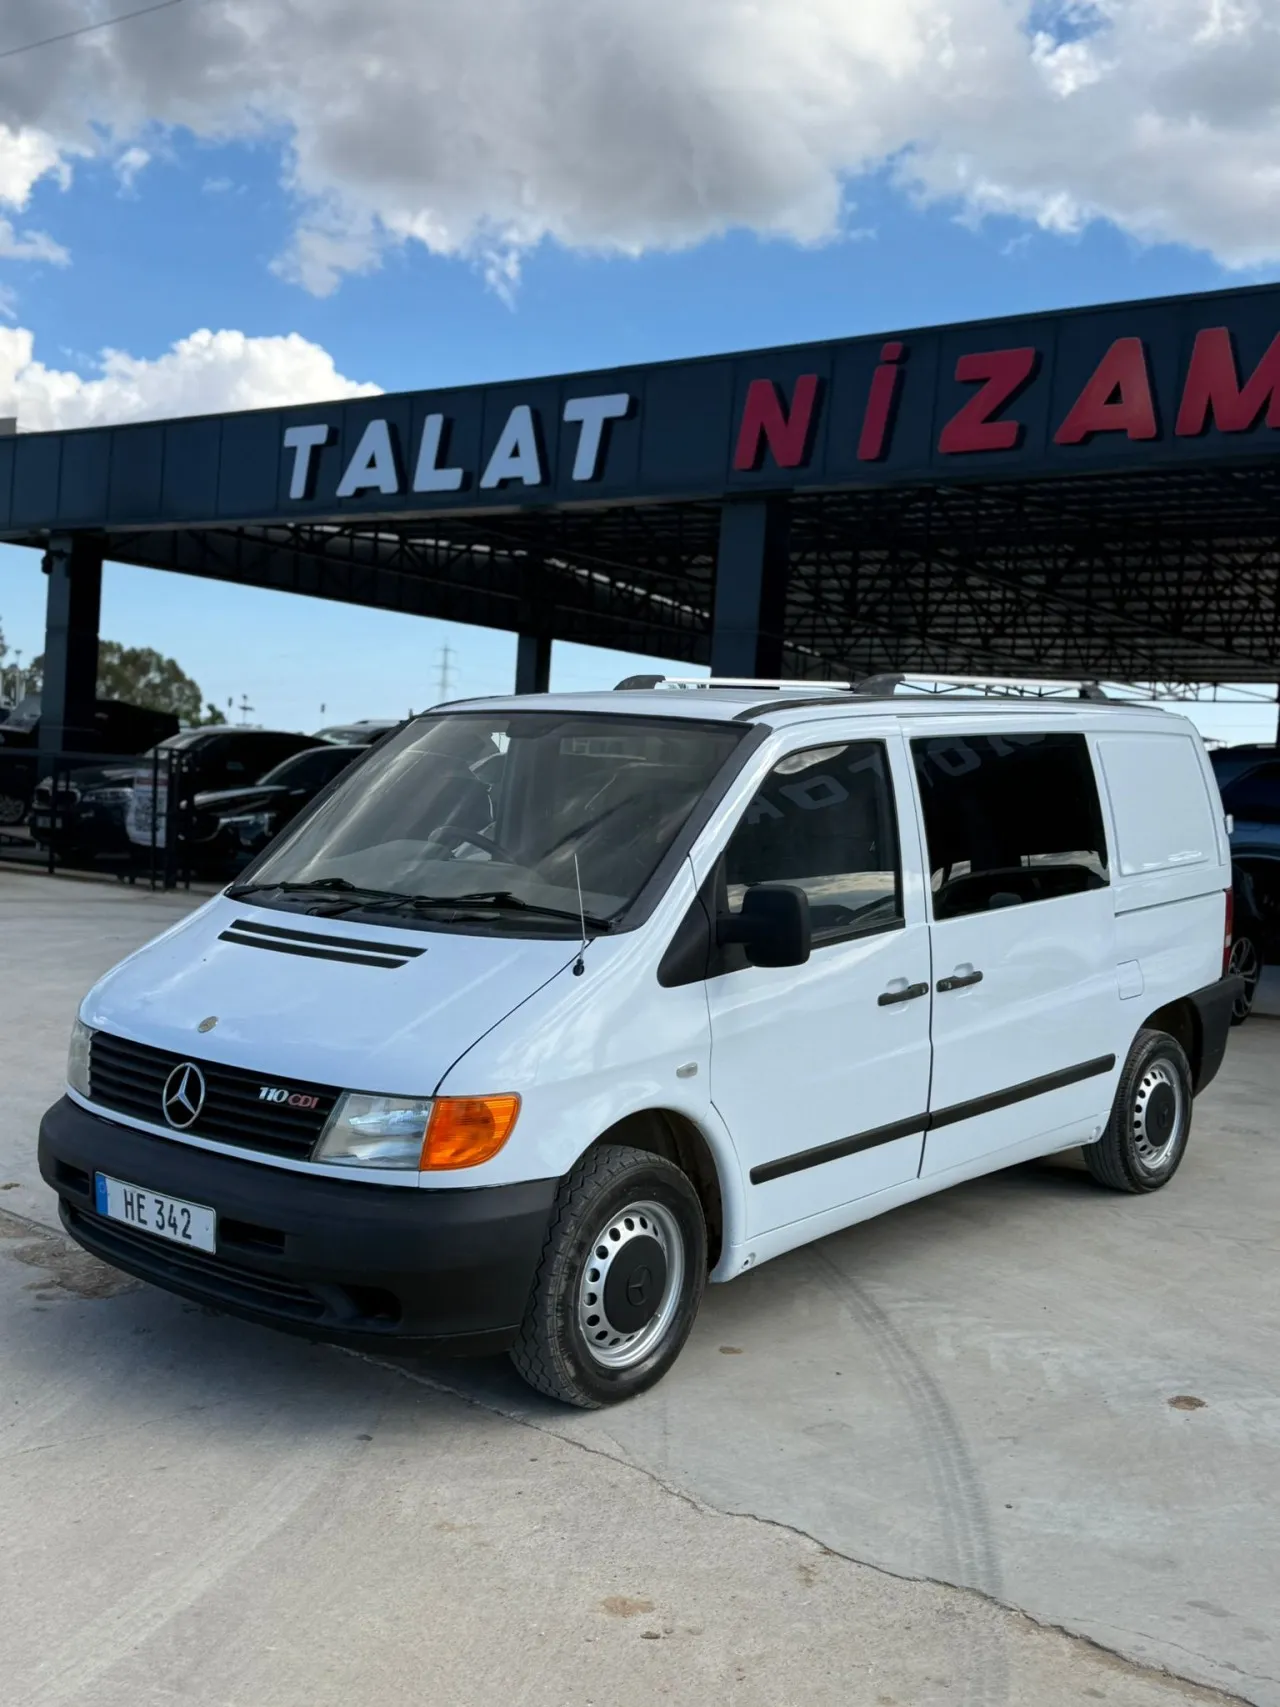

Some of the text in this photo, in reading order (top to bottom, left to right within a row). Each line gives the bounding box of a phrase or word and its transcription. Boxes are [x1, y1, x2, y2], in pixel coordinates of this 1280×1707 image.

[284, 393, 630, 499] TALAT
[123, 1188, 192, 1240] HE 342
